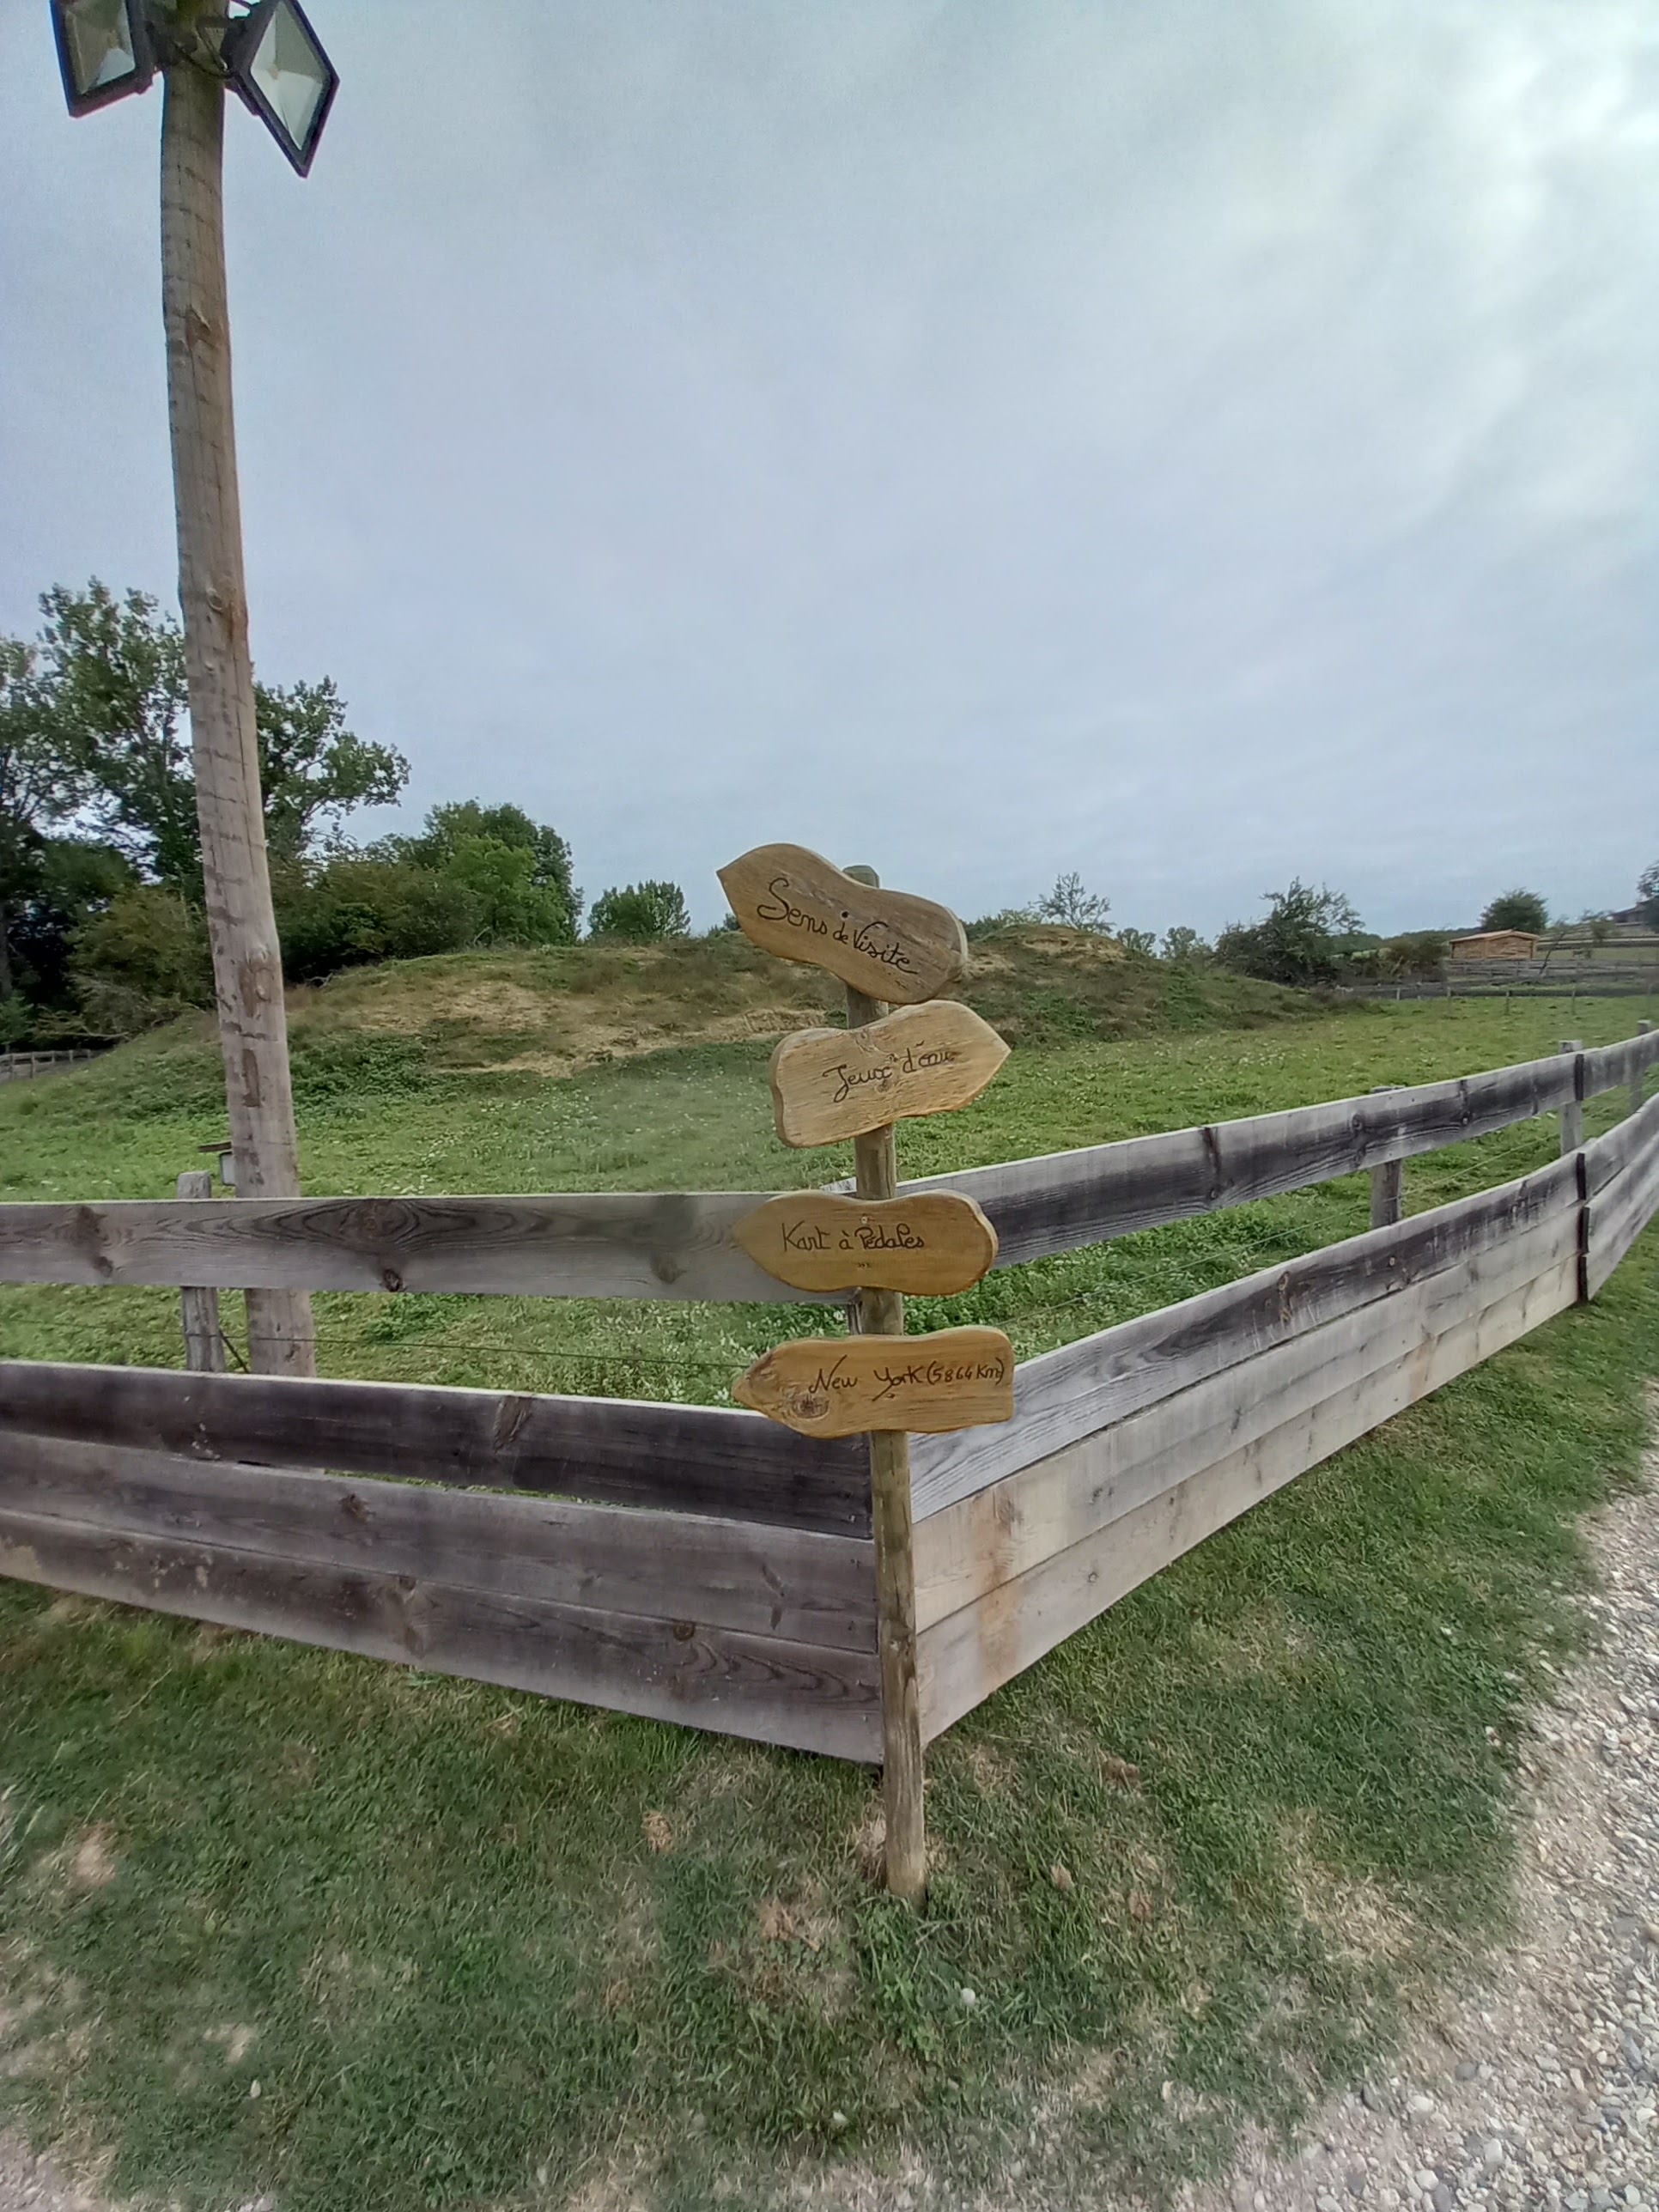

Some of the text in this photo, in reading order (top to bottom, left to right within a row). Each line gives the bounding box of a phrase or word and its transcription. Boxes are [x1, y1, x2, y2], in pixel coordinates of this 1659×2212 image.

[757, 878, 919, 975] Sens de Visite
[822, 1064, 893, 1103] Jeux
[781, 1220, 925, 1252] Kart à Pédales
[808, 1354, 859, 1394] New
